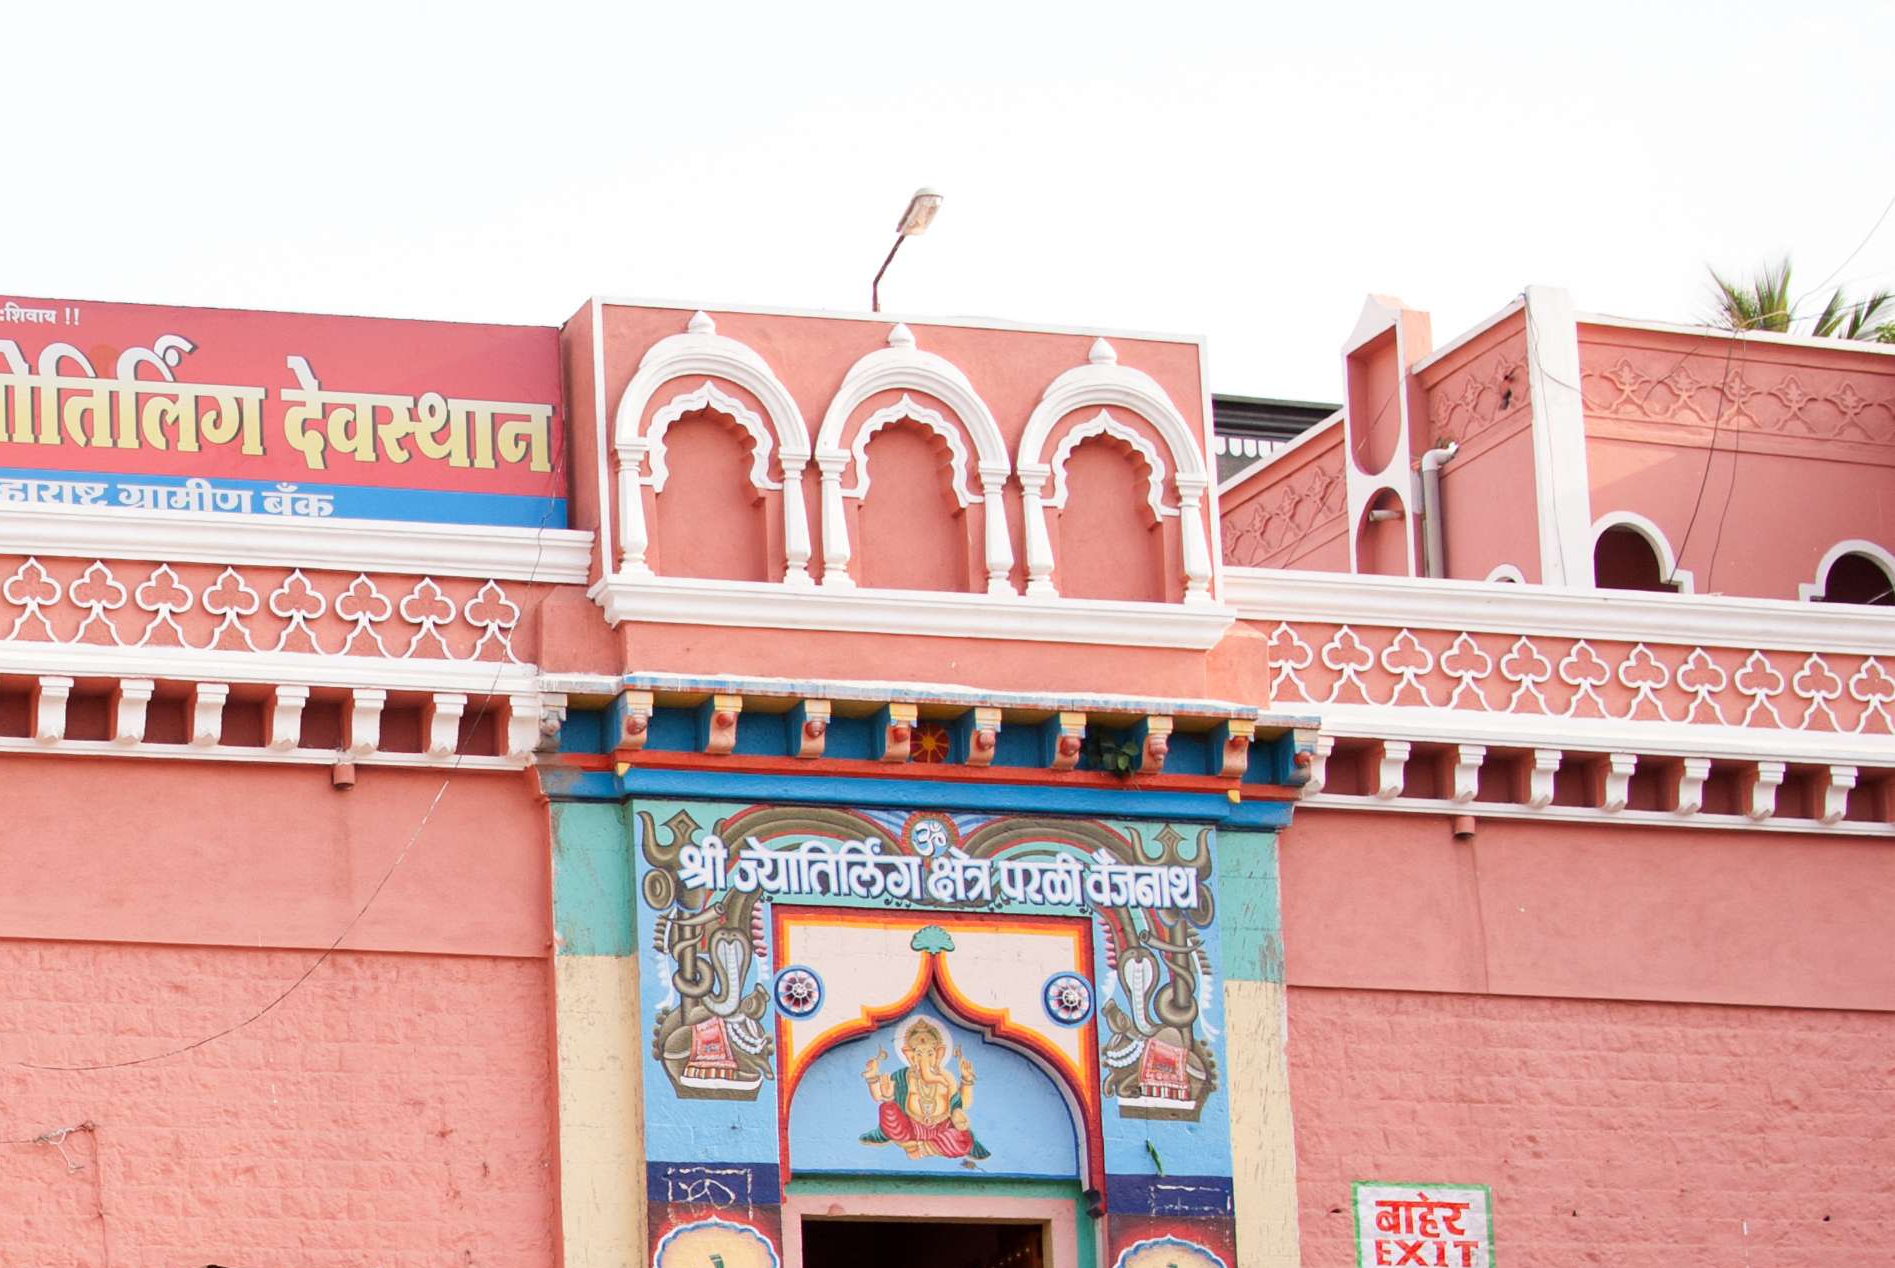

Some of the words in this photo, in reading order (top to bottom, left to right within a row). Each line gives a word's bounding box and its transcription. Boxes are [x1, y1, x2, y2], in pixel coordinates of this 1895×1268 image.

[281, 356, 555, 473] देवस्थान
[117, 478, 254, 514] ग्रामीण
[677, 834, 728, 891] श्री
[927, 845, 994, 902] क्षेत्र
[998, 853, 1085, 906] परळी
[1375, 1191, 1470, 1238] बाहेर
[1375, 1239, 1479, 1268] EXIT
